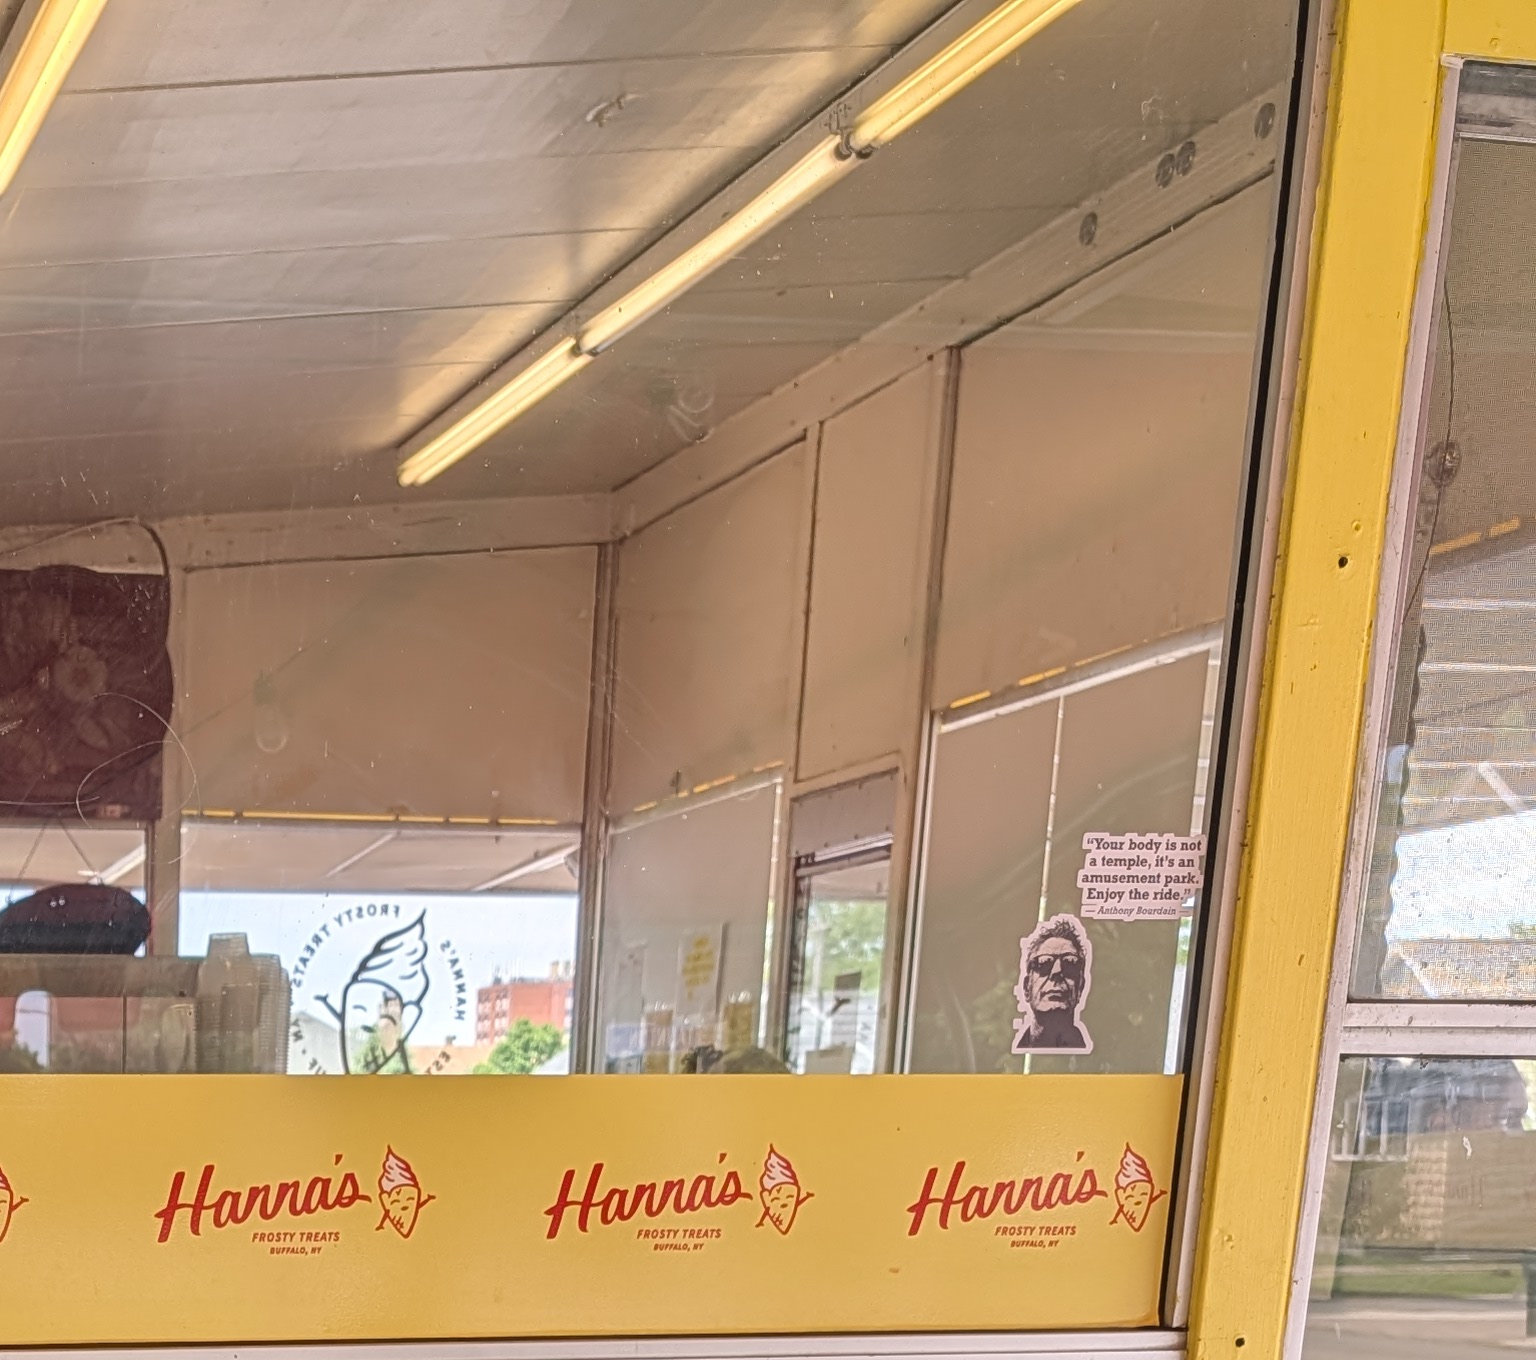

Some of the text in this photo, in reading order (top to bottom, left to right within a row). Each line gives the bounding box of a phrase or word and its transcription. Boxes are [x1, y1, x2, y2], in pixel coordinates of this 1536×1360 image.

[1128, 838, 1162, 854] body
[1165, 839, 1177, 850] is
[1180, 839, 1202, 851] not
[1089, 855, 1195, 870] a temple, it's an
[1081, 872, 1199, 887] amusement park.
[1086, 888, 1125, 903] Enjoy
[1129, 888, 1149, 900] the
[1097, 906, 1176, 916] Anthony Bourdain
[154, 1154, 372, 1243] Hanna's
[544, 1153, 753, 1239] Hanna's
[906, 1151, 1108, 1236] Hanna's
[252, 1231, 340, 1243] FROSTY TREATS
[636, 1228, 722, 1239] FROSTY TREATS
[994, 1225, 1077, 1237] FROSTY TREATS
[269, 1246, 323, 1256] BUFFALO, NY
[653, 1243, 704, 1252] BUFFALO, NY
[1010, 1240, 1060, 1249] BUFFALO, NY
